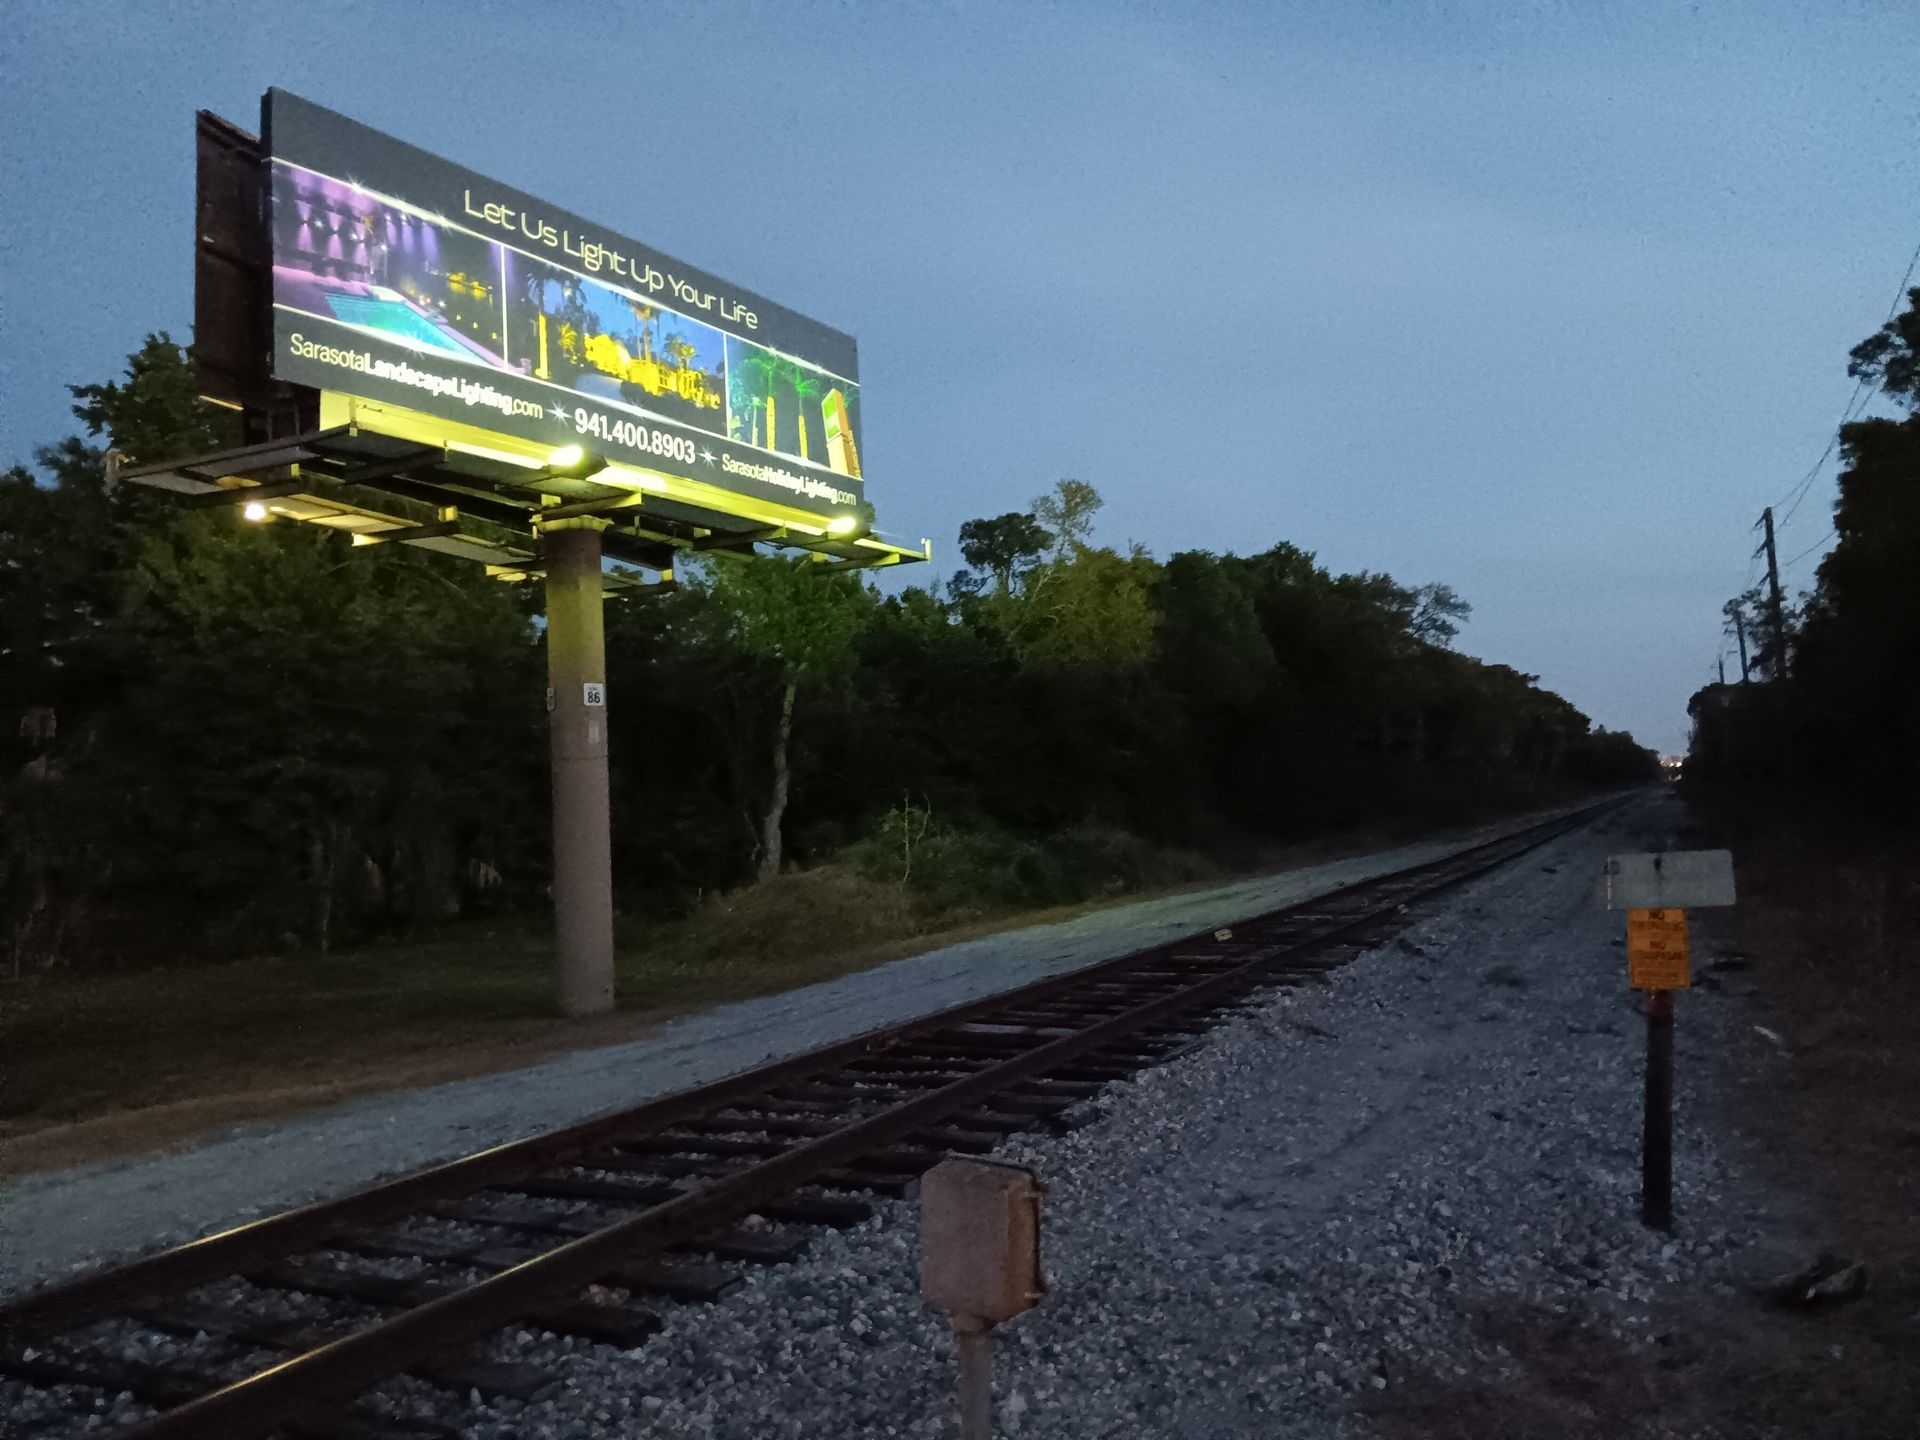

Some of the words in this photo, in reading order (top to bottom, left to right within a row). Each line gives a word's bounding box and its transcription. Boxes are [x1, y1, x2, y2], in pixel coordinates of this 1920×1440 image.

[464, 189, 517, 231] Let
[521, 212, 559, 247] Us
[563, 230, 627, 275] Light
[630, 258, 665, 293] Up
[667, 273, 717, 311] Your
[720, 296, 758, 330] Life
[290, 333, 543, 419] SarasotaLandscapeLighting.com
[574, 407, 696, 464] 941.400.8903
[587, 691, 601, 704] 86
